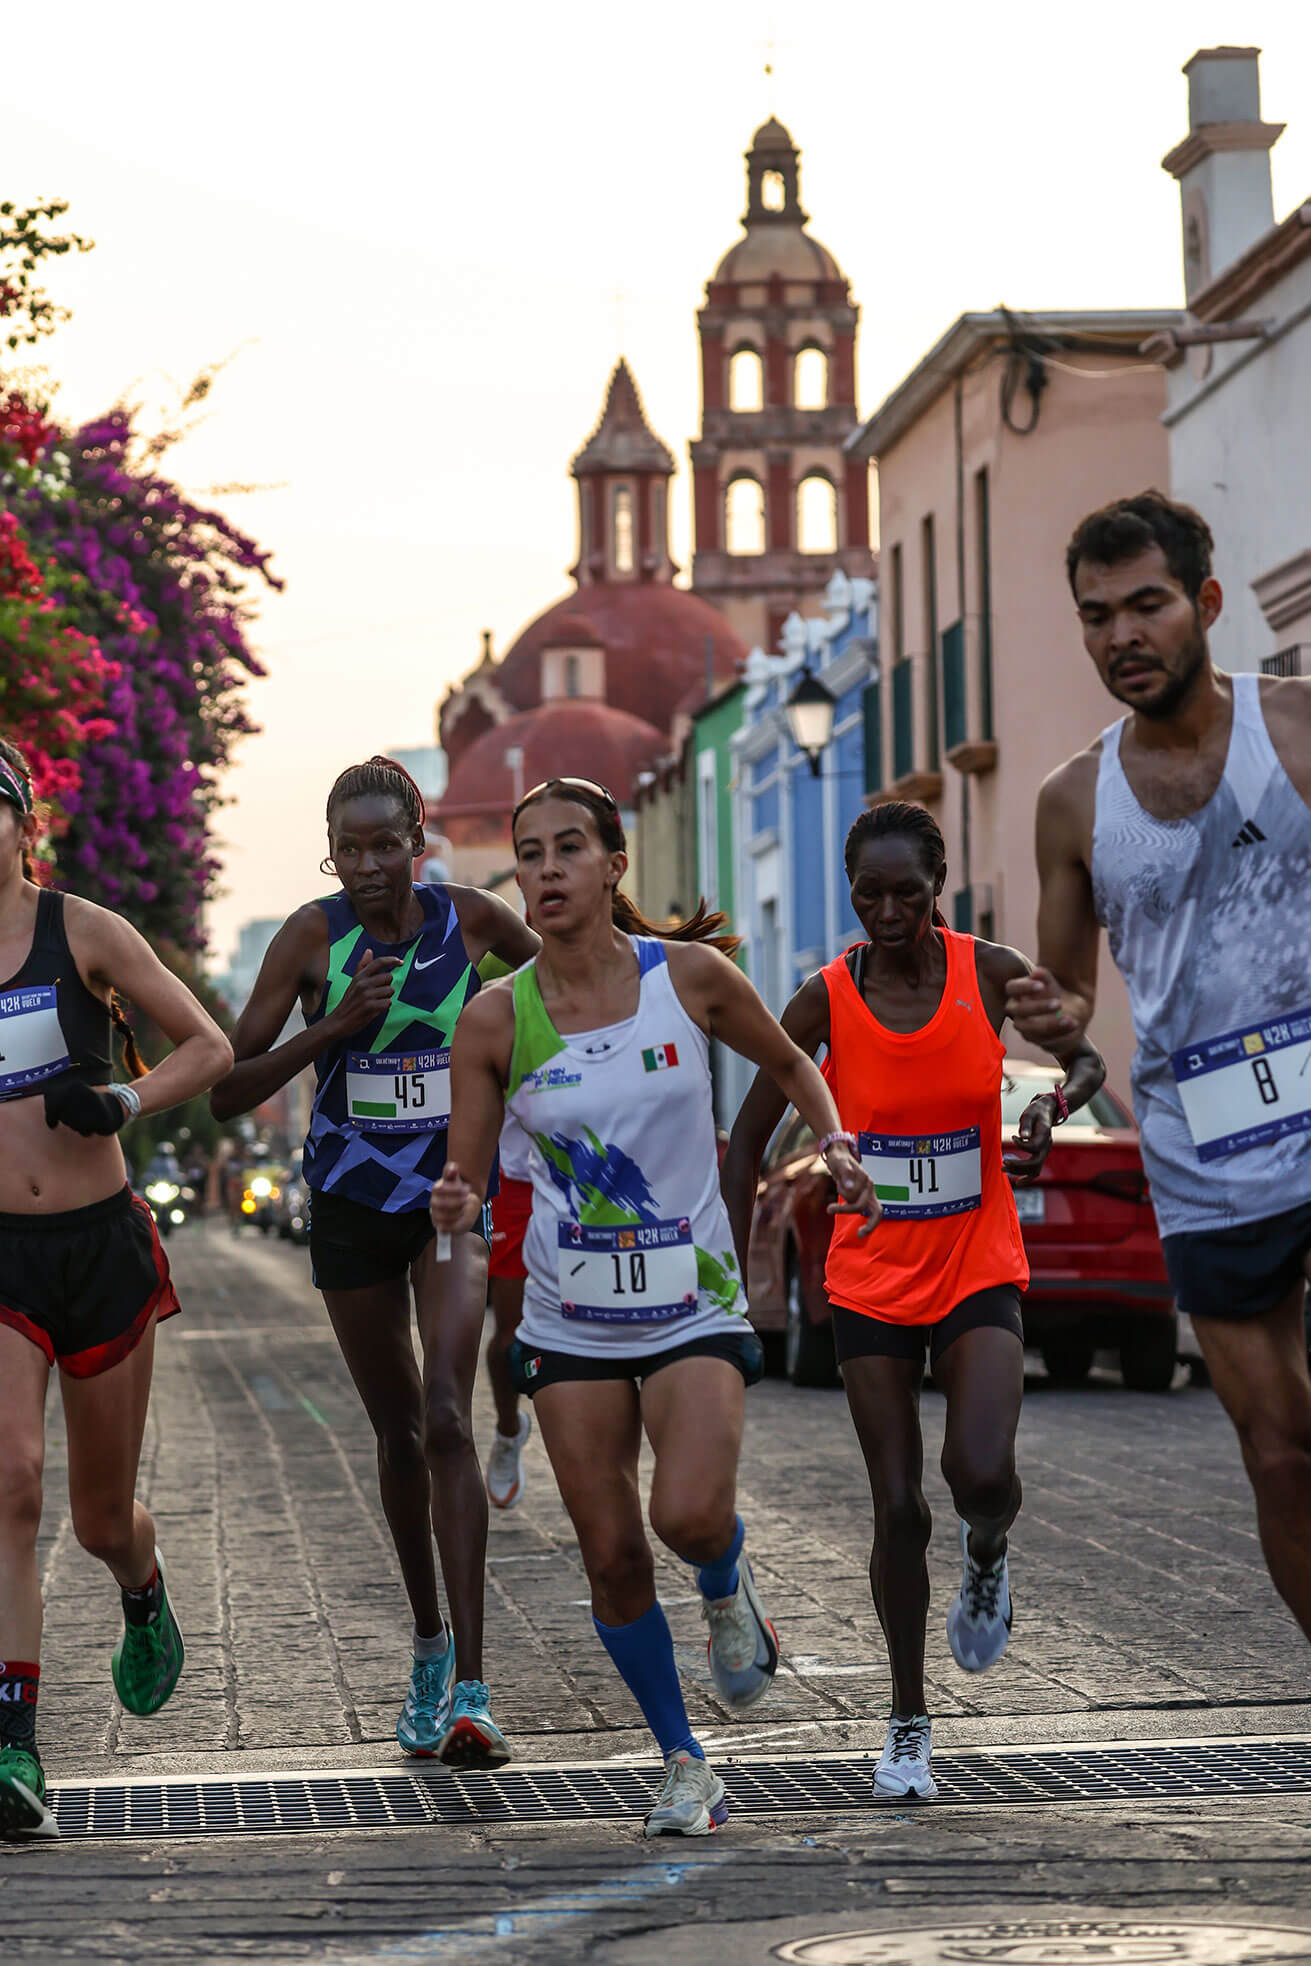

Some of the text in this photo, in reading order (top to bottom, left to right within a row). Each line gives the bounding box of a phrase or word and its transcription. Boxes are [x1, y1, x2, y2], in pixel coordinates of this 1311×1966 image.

[1, 995, 20, 1013] 42K
[1262, 1023, 1291, 1045] 42K
[418, 1054, 436, 1068] 42K
[395, 1074, 425, 1109] 45
[1252, 1057, 1279, 1105] 8
[933, 1138, 951, 1152] 42K
[909, 1158, 939, 1193] 41
[637, 1227, 659, 1245] 42K
[611, 1252, 647, 1294] 10
